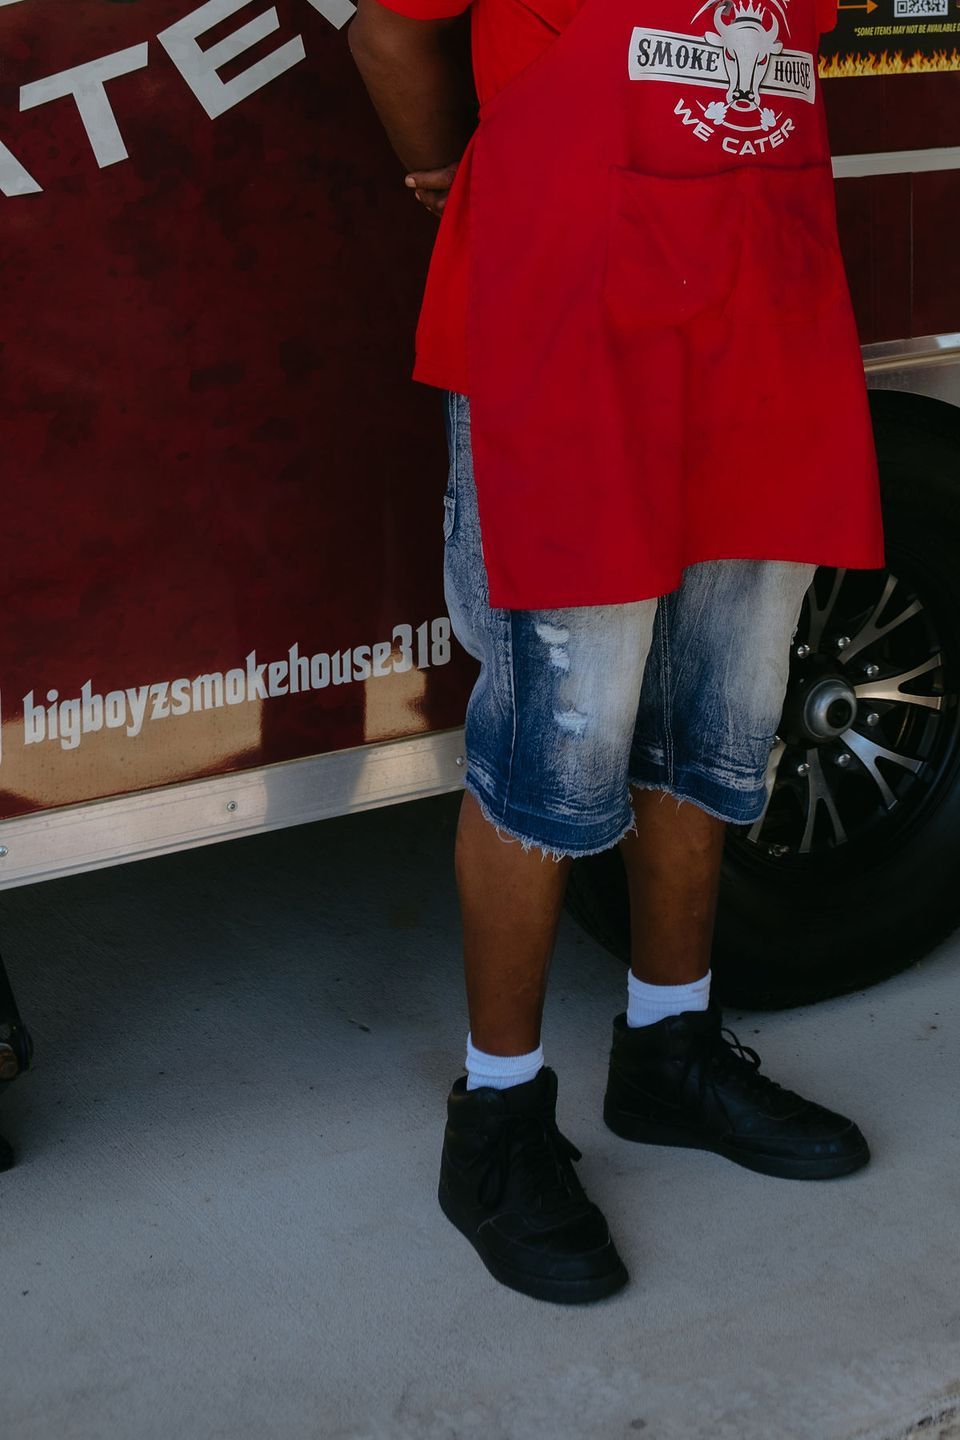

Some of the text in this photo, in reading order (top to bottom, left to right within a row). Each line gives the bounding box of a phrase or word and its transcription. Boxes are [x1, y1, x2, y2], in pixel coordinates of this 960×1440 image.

[875, 25, 892, 35] ITEMS
[893, 25, 905, 34] MAY
[906, 24, 918, 34] NOT
[919, 24, 926, 33] BE
[927, 23, 956, 32] AVAILABLE
[637, 39, 810, 90] SMOKE HOUSE
[674, 98, 795, 155] WE CATER
[22, 616, 451, 751] bigboyzsmokehouse318
